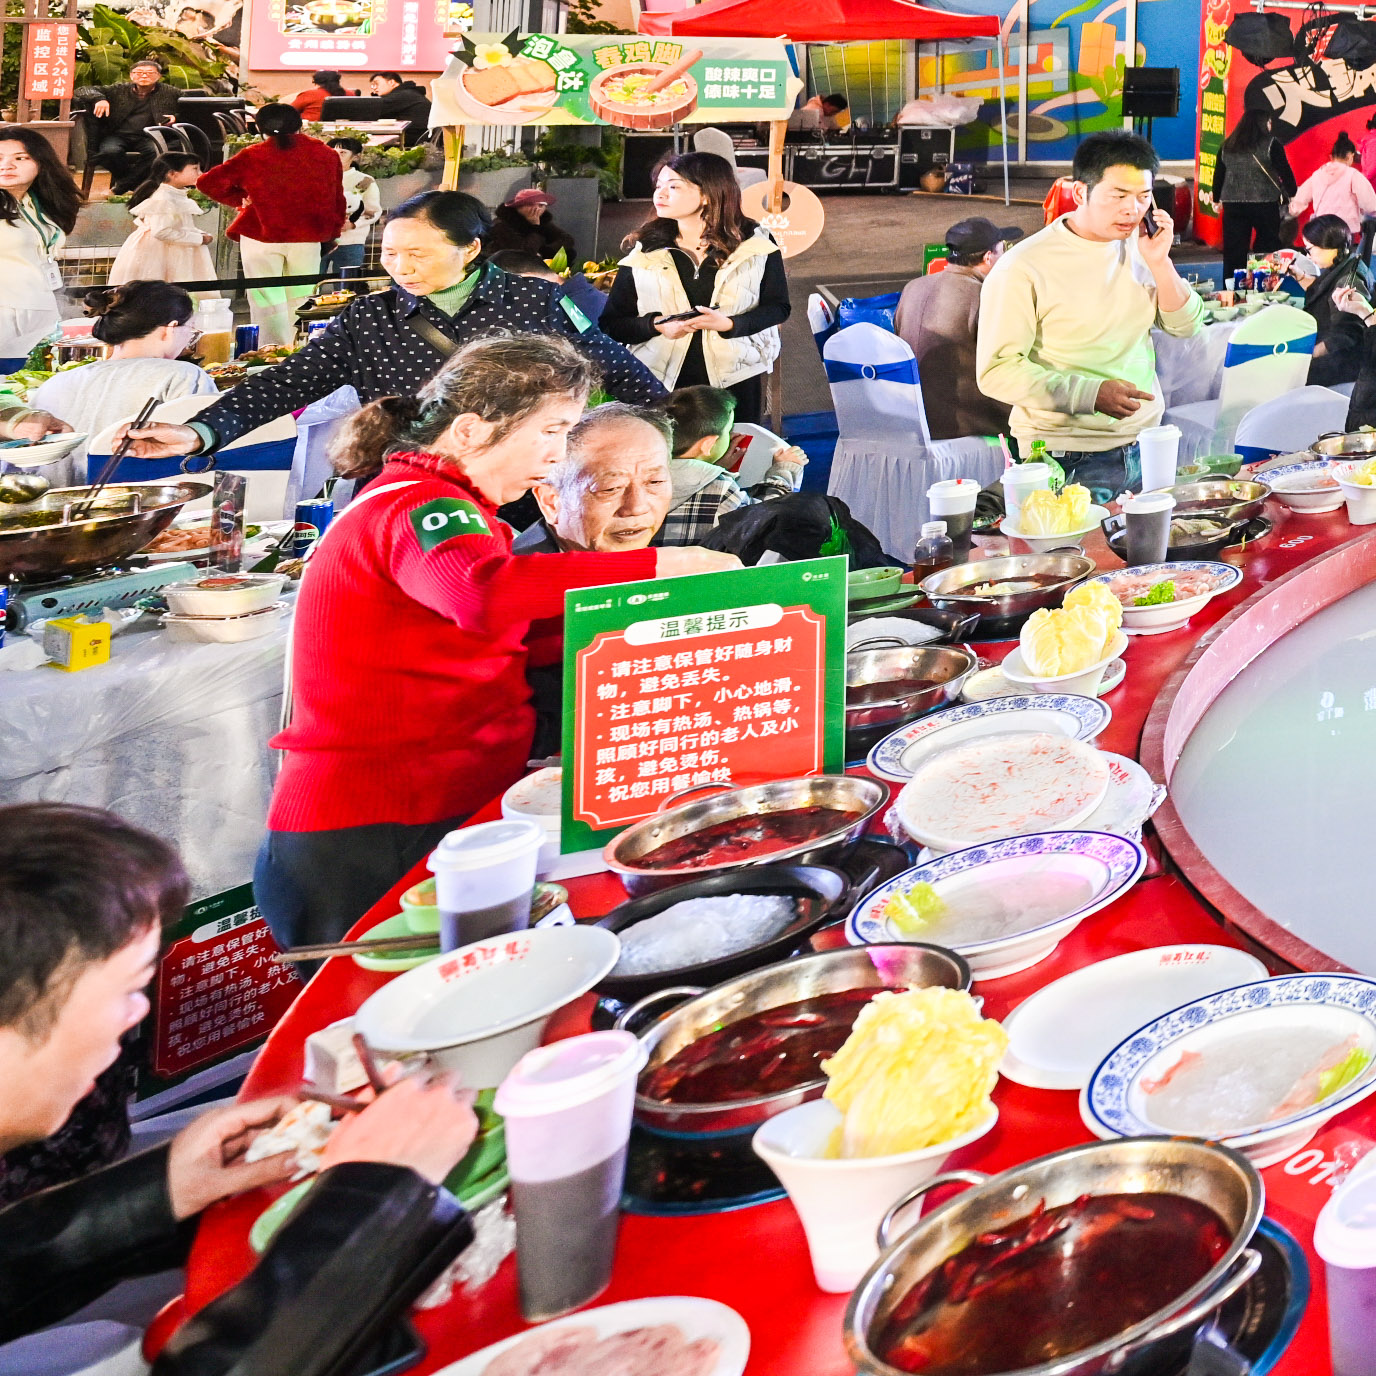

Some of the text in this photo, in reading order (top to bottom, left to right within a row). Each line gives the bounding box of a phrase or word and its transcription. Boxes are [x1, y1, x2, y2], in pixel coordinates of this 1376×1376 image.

[31, 28, 52, 92] 监控区域
[52, 26, 69, 97] 您已进入24小时
[525, 35, 584, 91] 泡鲁达
[705, 67, 776, 83] 酸辣爽口
[704, 84, 776, 99] 傣味十足
[660, 610, 749, 639] 温馨提示
[611, 636, 793, 679] 请注意保管好随身财
[597, 667, 730, 701] 物，避免丢失。
[610, 677, 801, 721] 注意脚下，小心地滑。
[596, 717, 798, 765] 照顾好同行的老人及小
[609, 698, 800, 743] 现场有热汤、热锅等，
[595, 749, 729, 786] 孩，避免烫伤。
[608, 767, 732, 803] 祝您用餐愉快
[170, 945, 266, 988] 物，避免丢失。
